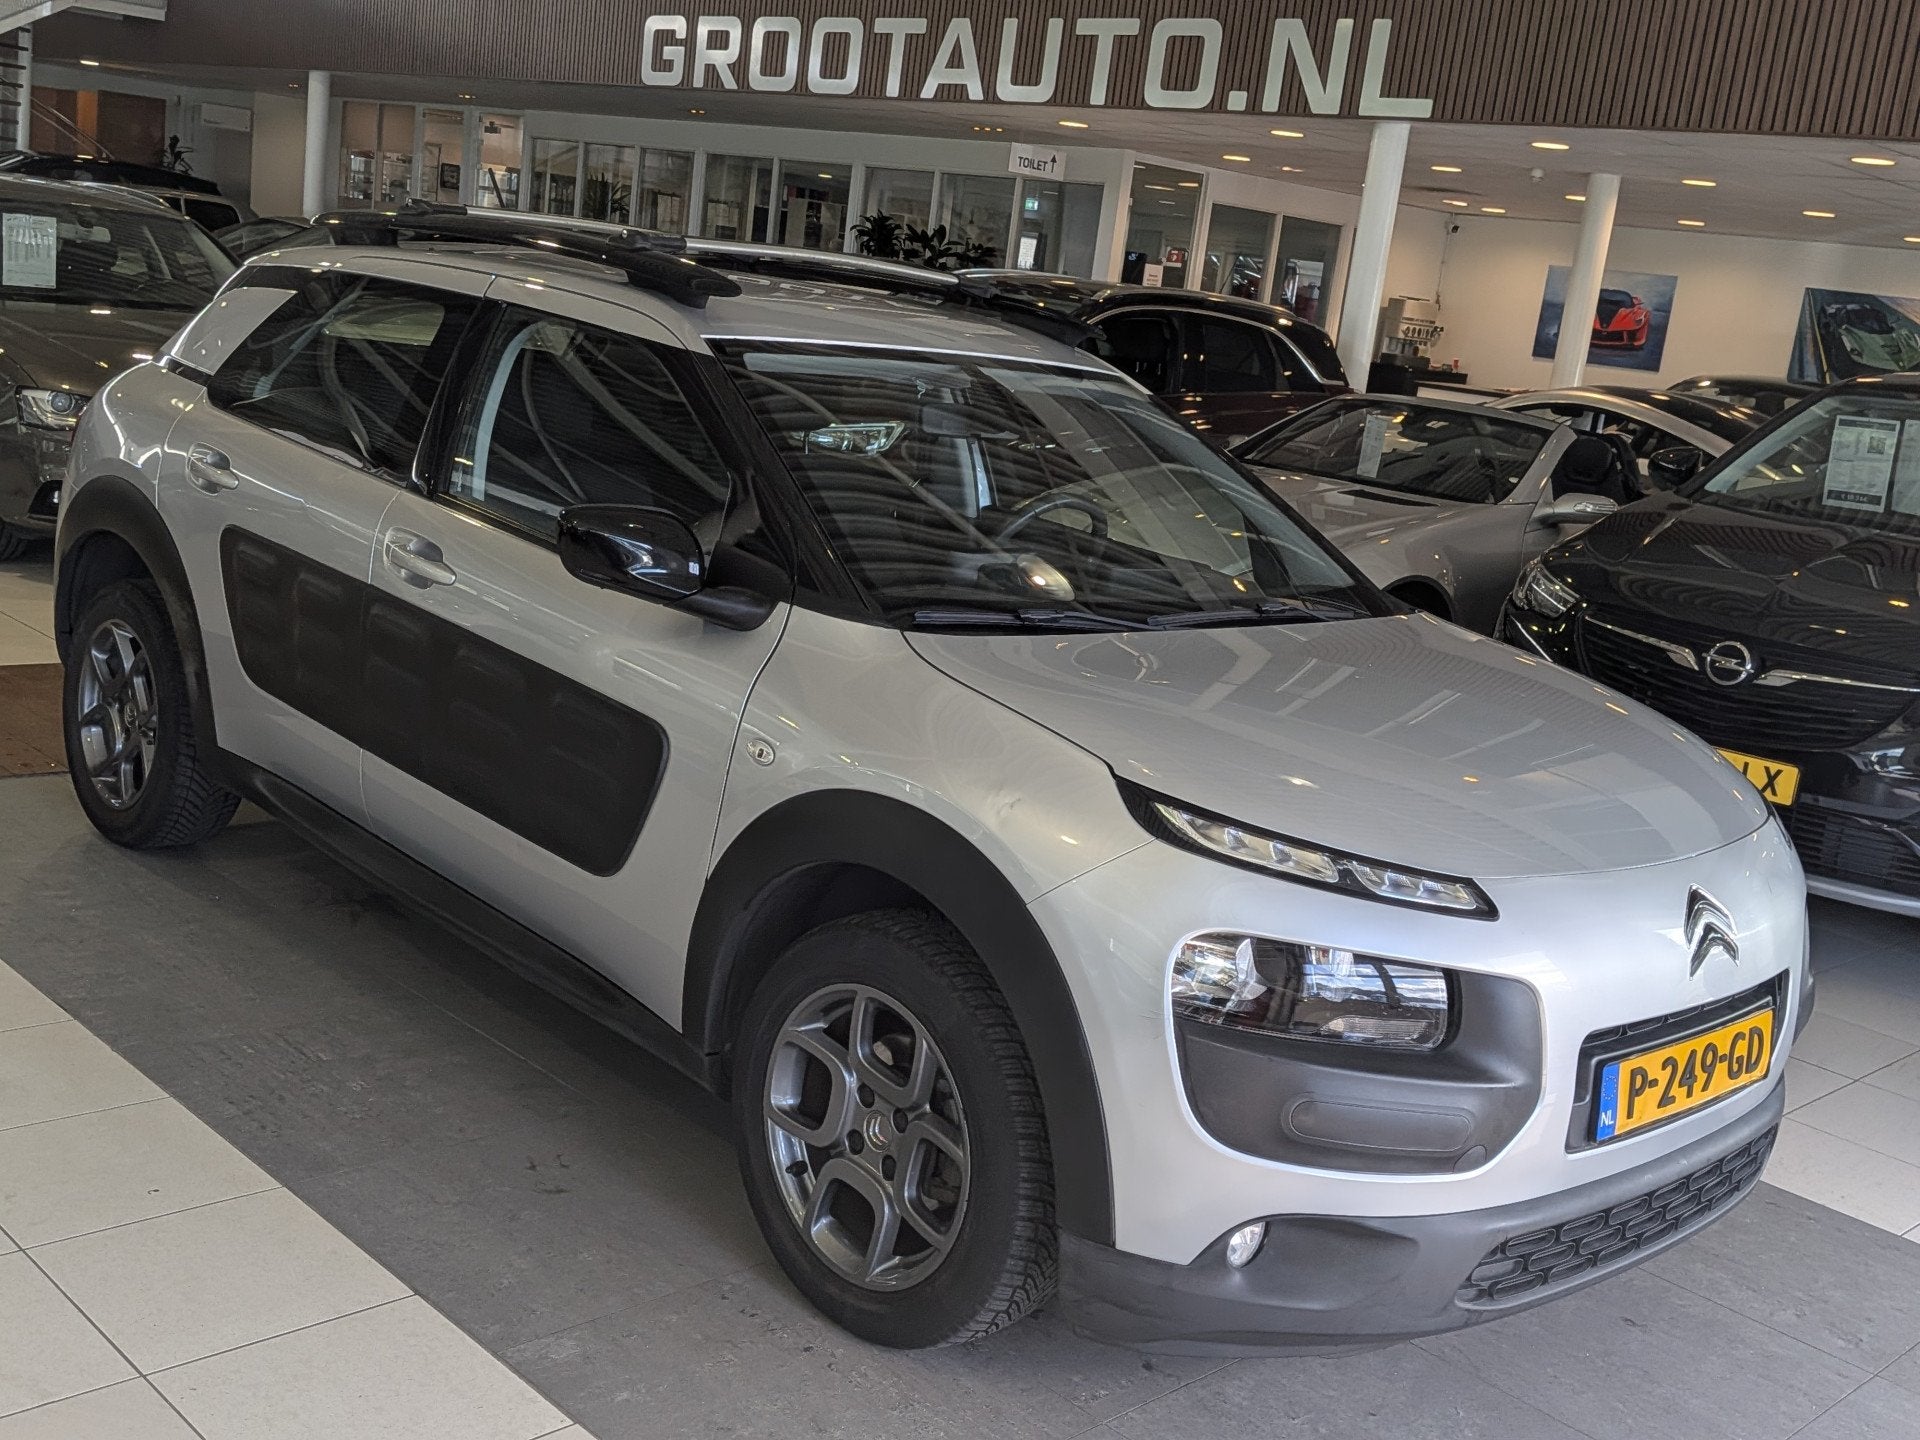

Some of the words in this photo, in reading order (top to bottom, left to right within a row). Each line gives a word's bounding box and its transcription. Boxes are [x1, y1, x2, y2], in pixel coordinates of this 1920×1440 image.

[641, 15, 1433, 118] GROOTAUTO.NL
[1018, 156, 1048, 171] TOILET
[1627, 1025, 1764, 1119] P-249-GD
[1600, 1110, 1614, 1125] NL
